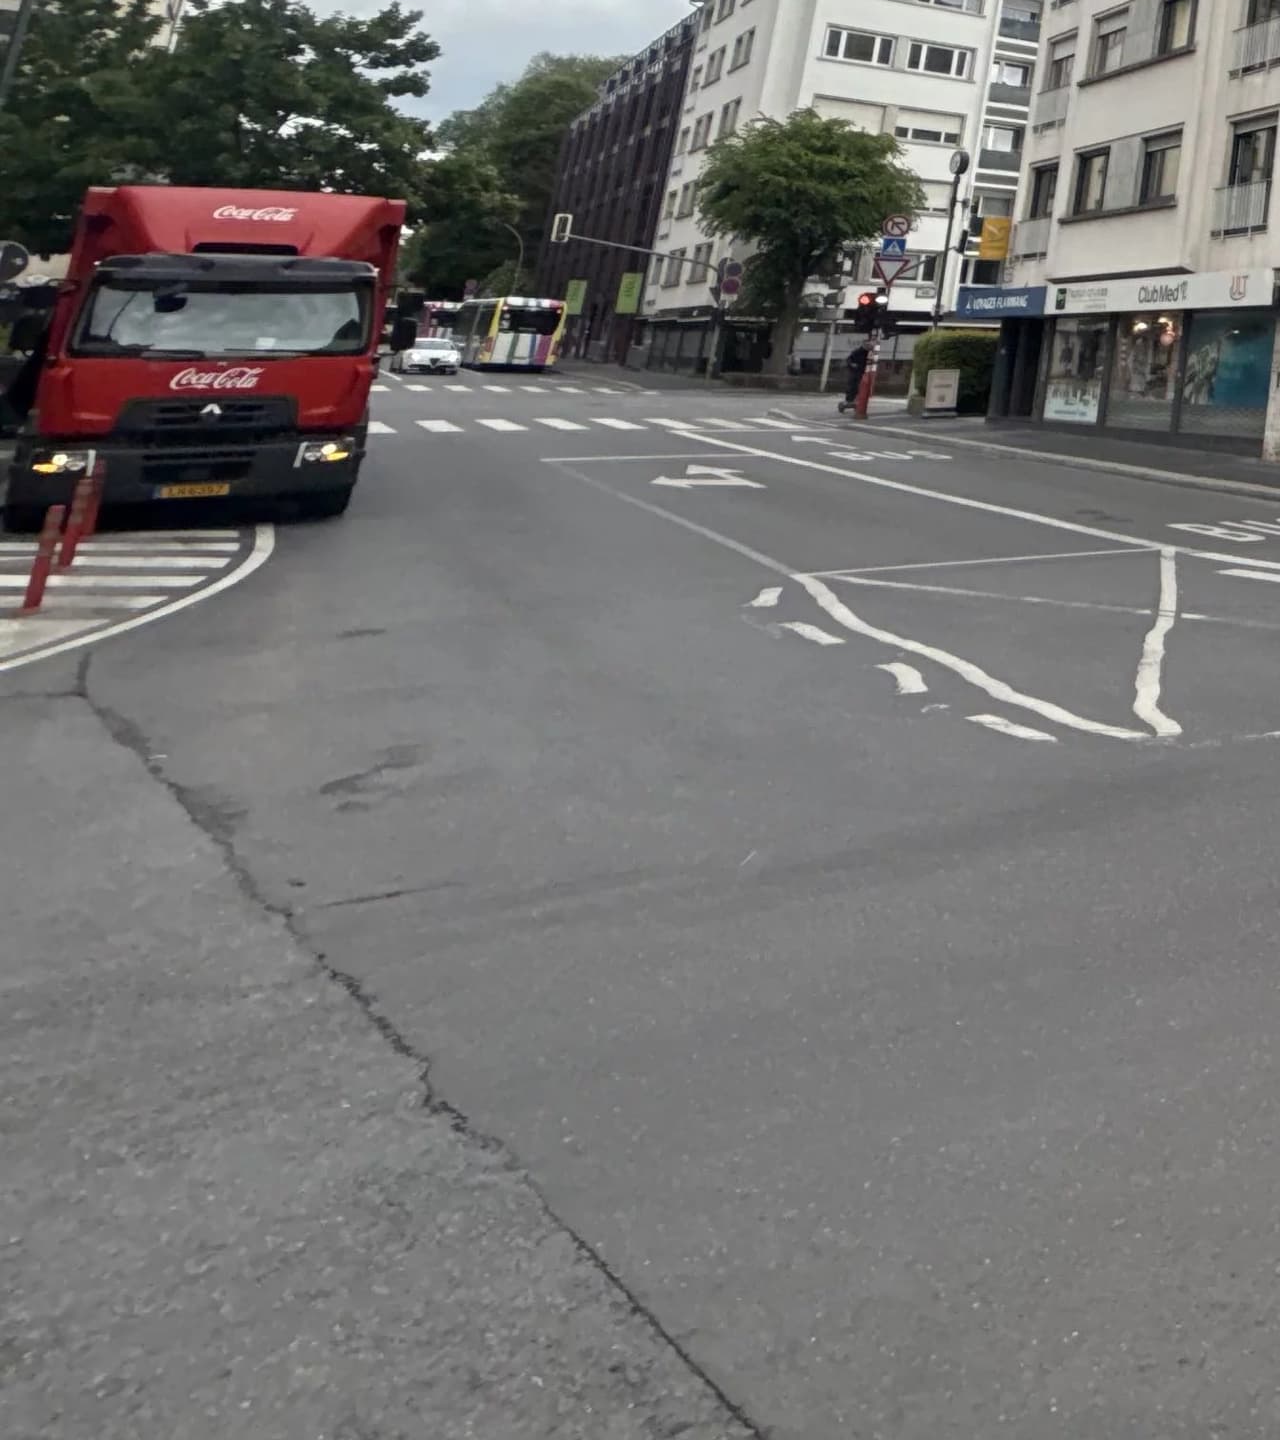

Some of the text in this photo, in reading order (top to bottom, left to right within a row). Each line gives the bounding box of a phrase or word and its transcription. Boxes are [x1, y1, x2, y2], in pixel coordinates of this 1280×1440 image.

[1138, 284, 1179, 303] Club Med
[169, 367, 264, 390] Coca-Cola
[825, 450, 953, 460] BUS
